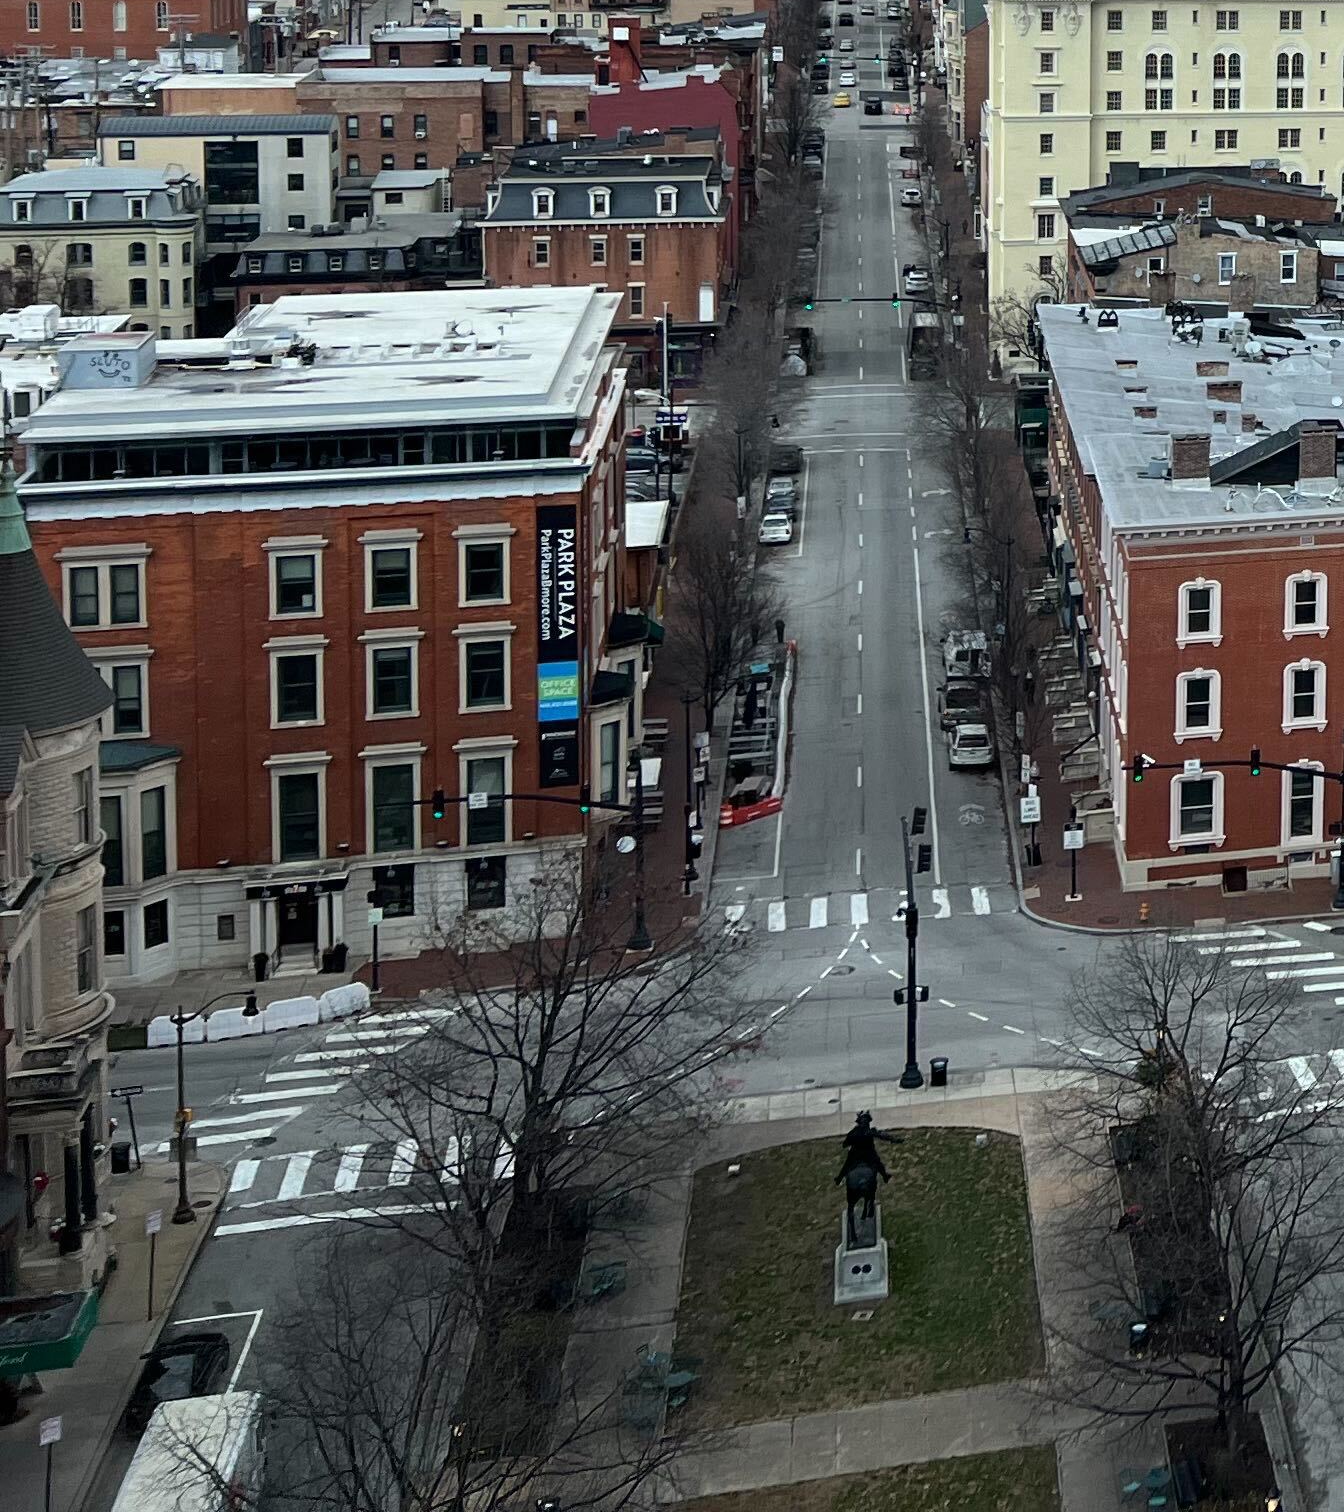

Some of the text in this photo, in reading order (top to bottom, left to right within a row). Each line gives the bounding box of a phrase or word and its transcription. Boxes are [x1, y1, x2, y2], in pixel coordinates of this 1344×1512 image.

[541, 529, 552, 640] ParkPlazaBmore.com
[558, 529, 575, 639] PARK PLAZA
[541, 678, 577, 688] OFFICE
[543, 687, 574, 697] SPACE
